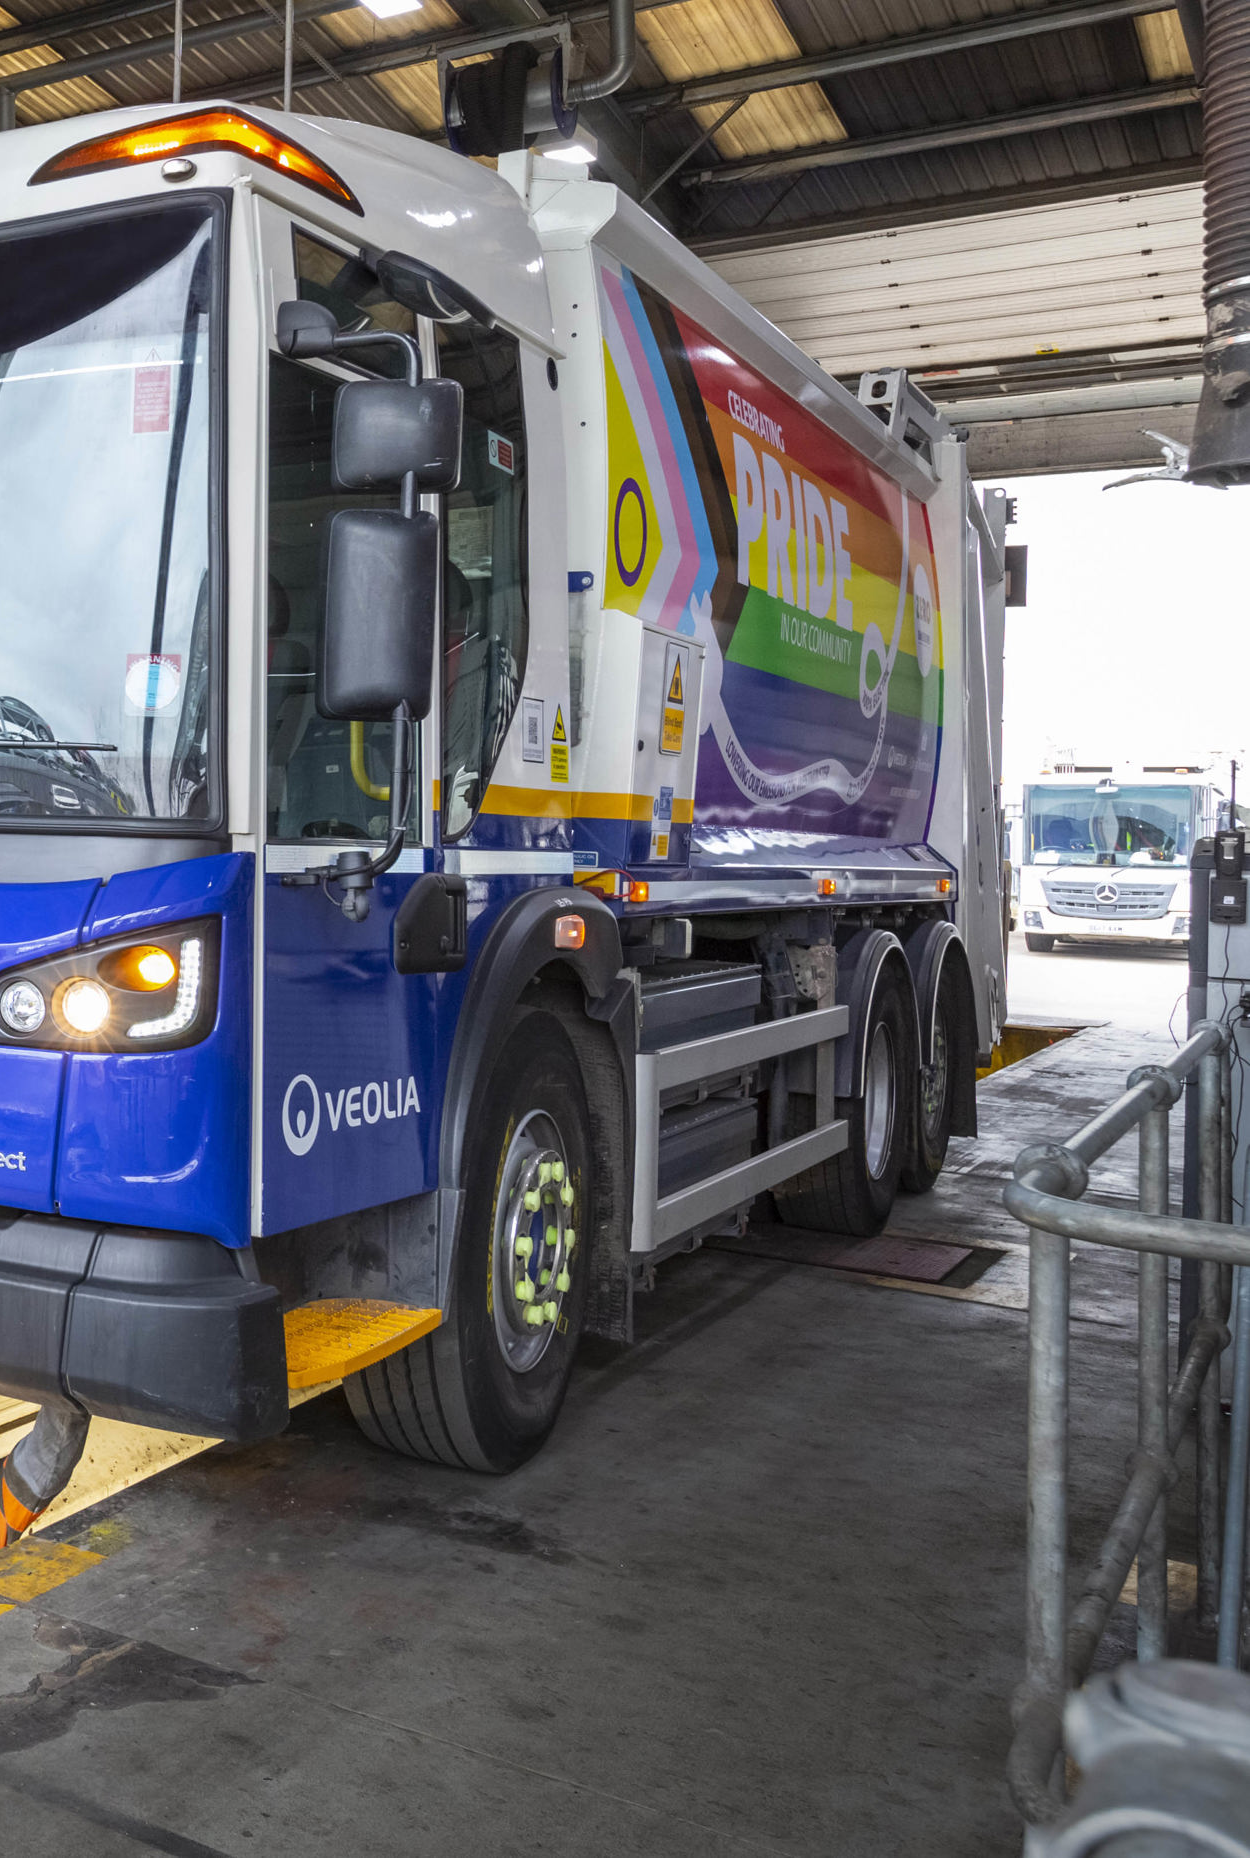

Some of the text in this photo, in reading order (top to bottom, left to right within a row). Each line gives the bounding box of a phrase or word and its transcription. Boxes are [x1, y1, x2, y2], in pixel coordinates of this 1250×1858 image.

[727, 389, 786, 453] CELEBRATING
[732, 431, 853, 632] PRIDE
[780, 612, 852, 665] IN OUR COMMUNITY
[324, 1075, 421, 1132] VEOLIA
